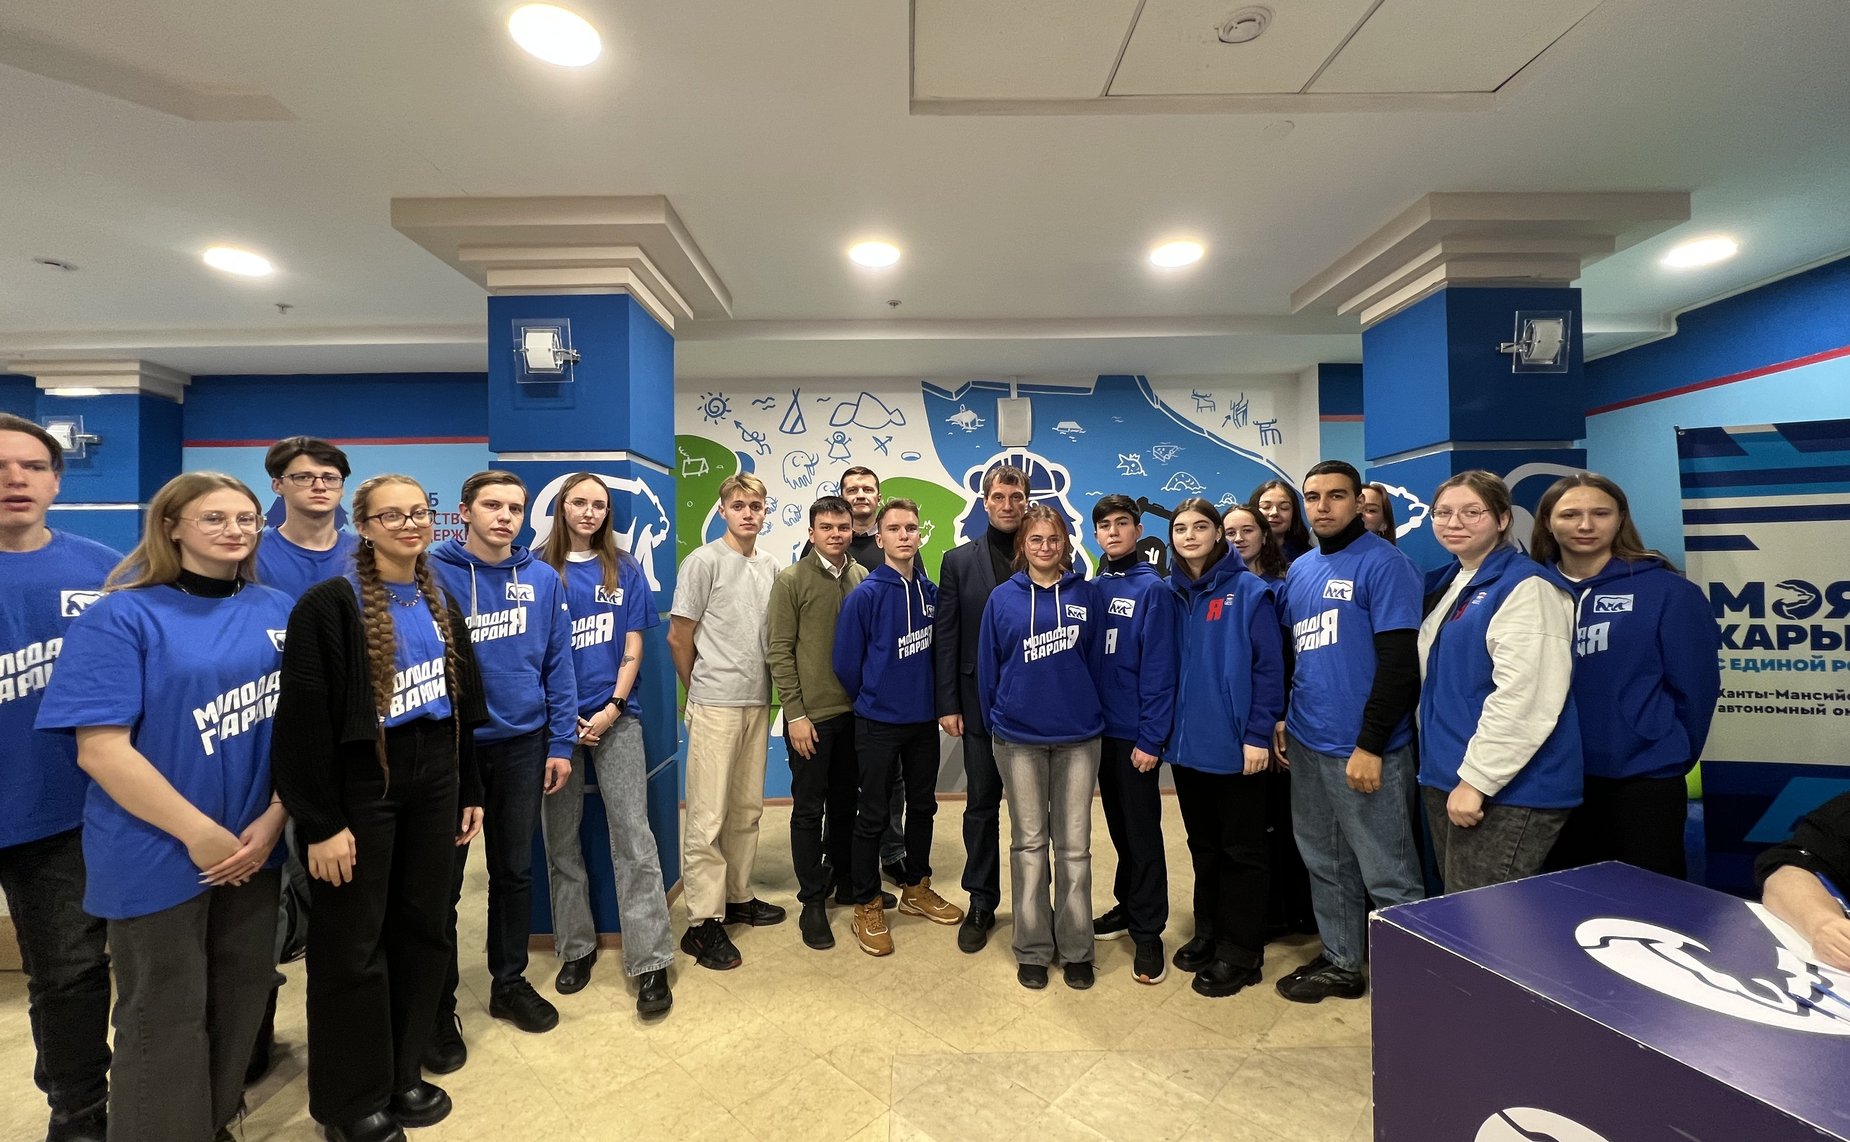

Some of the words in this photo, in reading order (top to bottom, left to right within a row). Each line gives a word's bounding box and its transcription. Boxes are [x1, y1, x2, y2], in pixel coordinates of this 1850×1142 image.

[1718, 624, 1850, 651] КАРЬ
[1730, 655, 1826, 672] ЕДИНОЙ
[1832, 660, 1850, 672] Р
[1718, 704, 1826, 715] автономный
